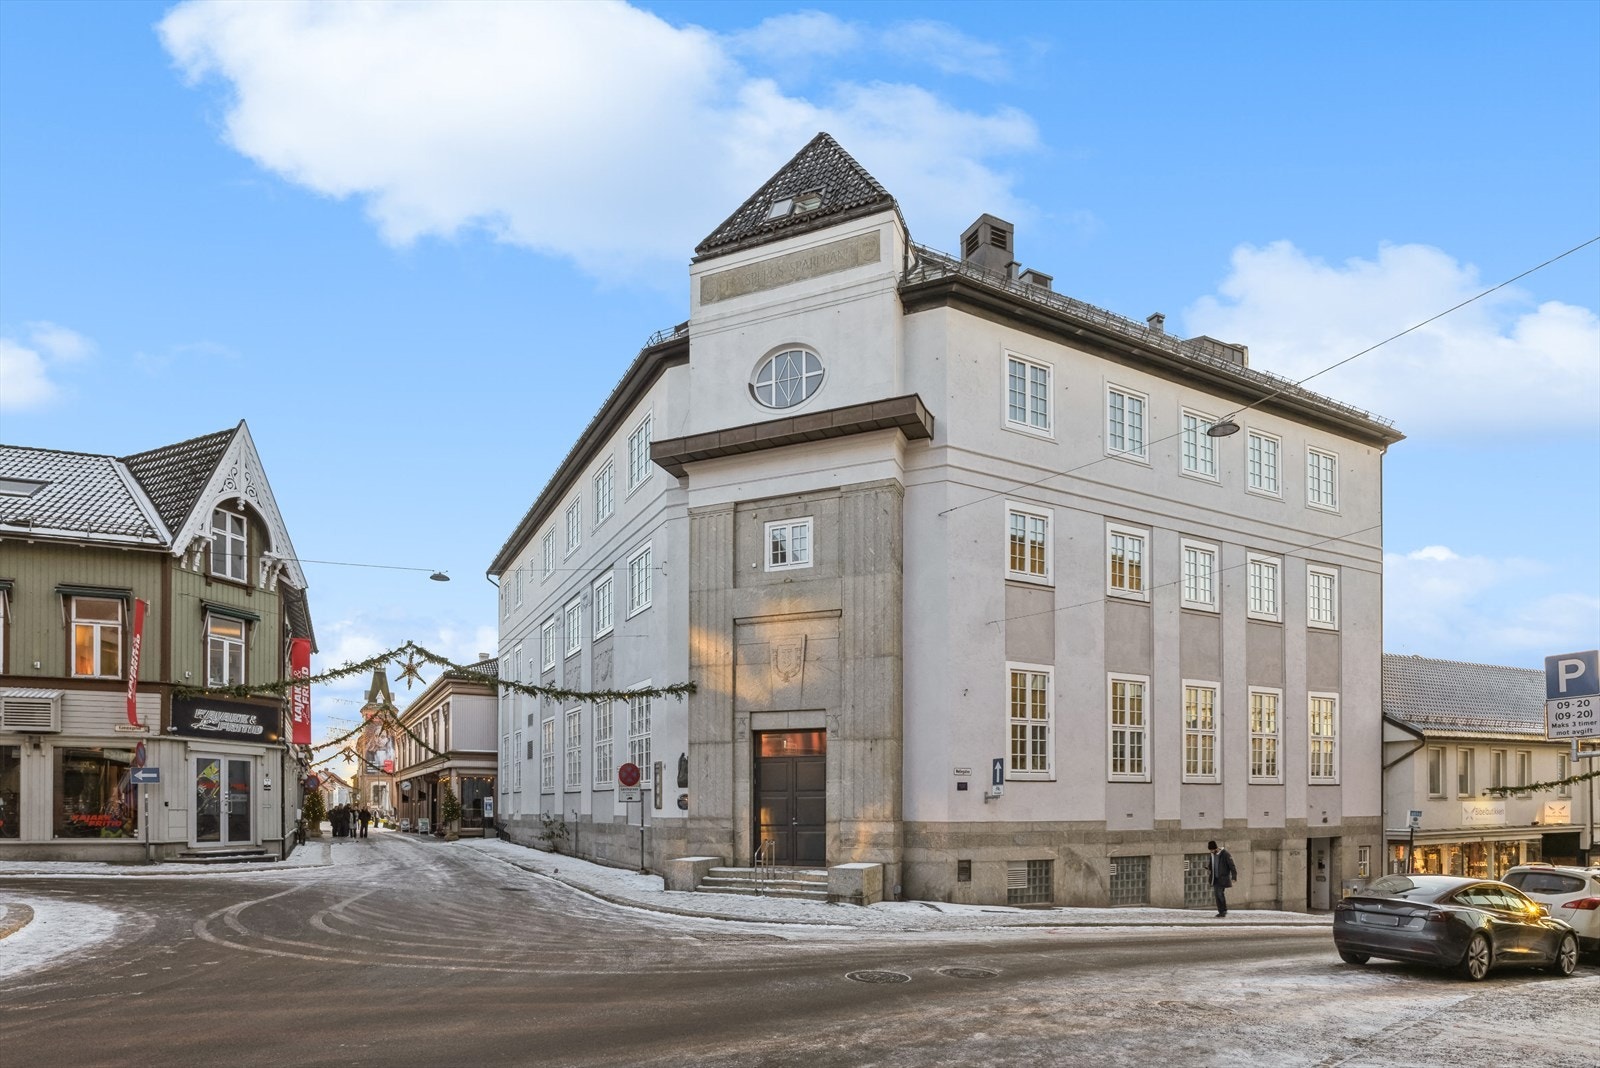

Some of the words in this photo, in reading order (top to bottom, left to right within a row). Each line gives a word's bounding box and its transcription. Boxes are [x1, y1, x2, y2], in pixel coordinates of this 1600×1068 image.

[294, 670, 302, 679] &
[1558, 658, 1586, 693] P
[301, 666, 310, 705] FRID
[294, 683, 304, 723] KAJAK
[249, 714, 257, 725] &
[217, 721, 264, 735] FRITID
[1556, 728, 1570, 736] mot
[1572, 727, 1593, 736] avgift
